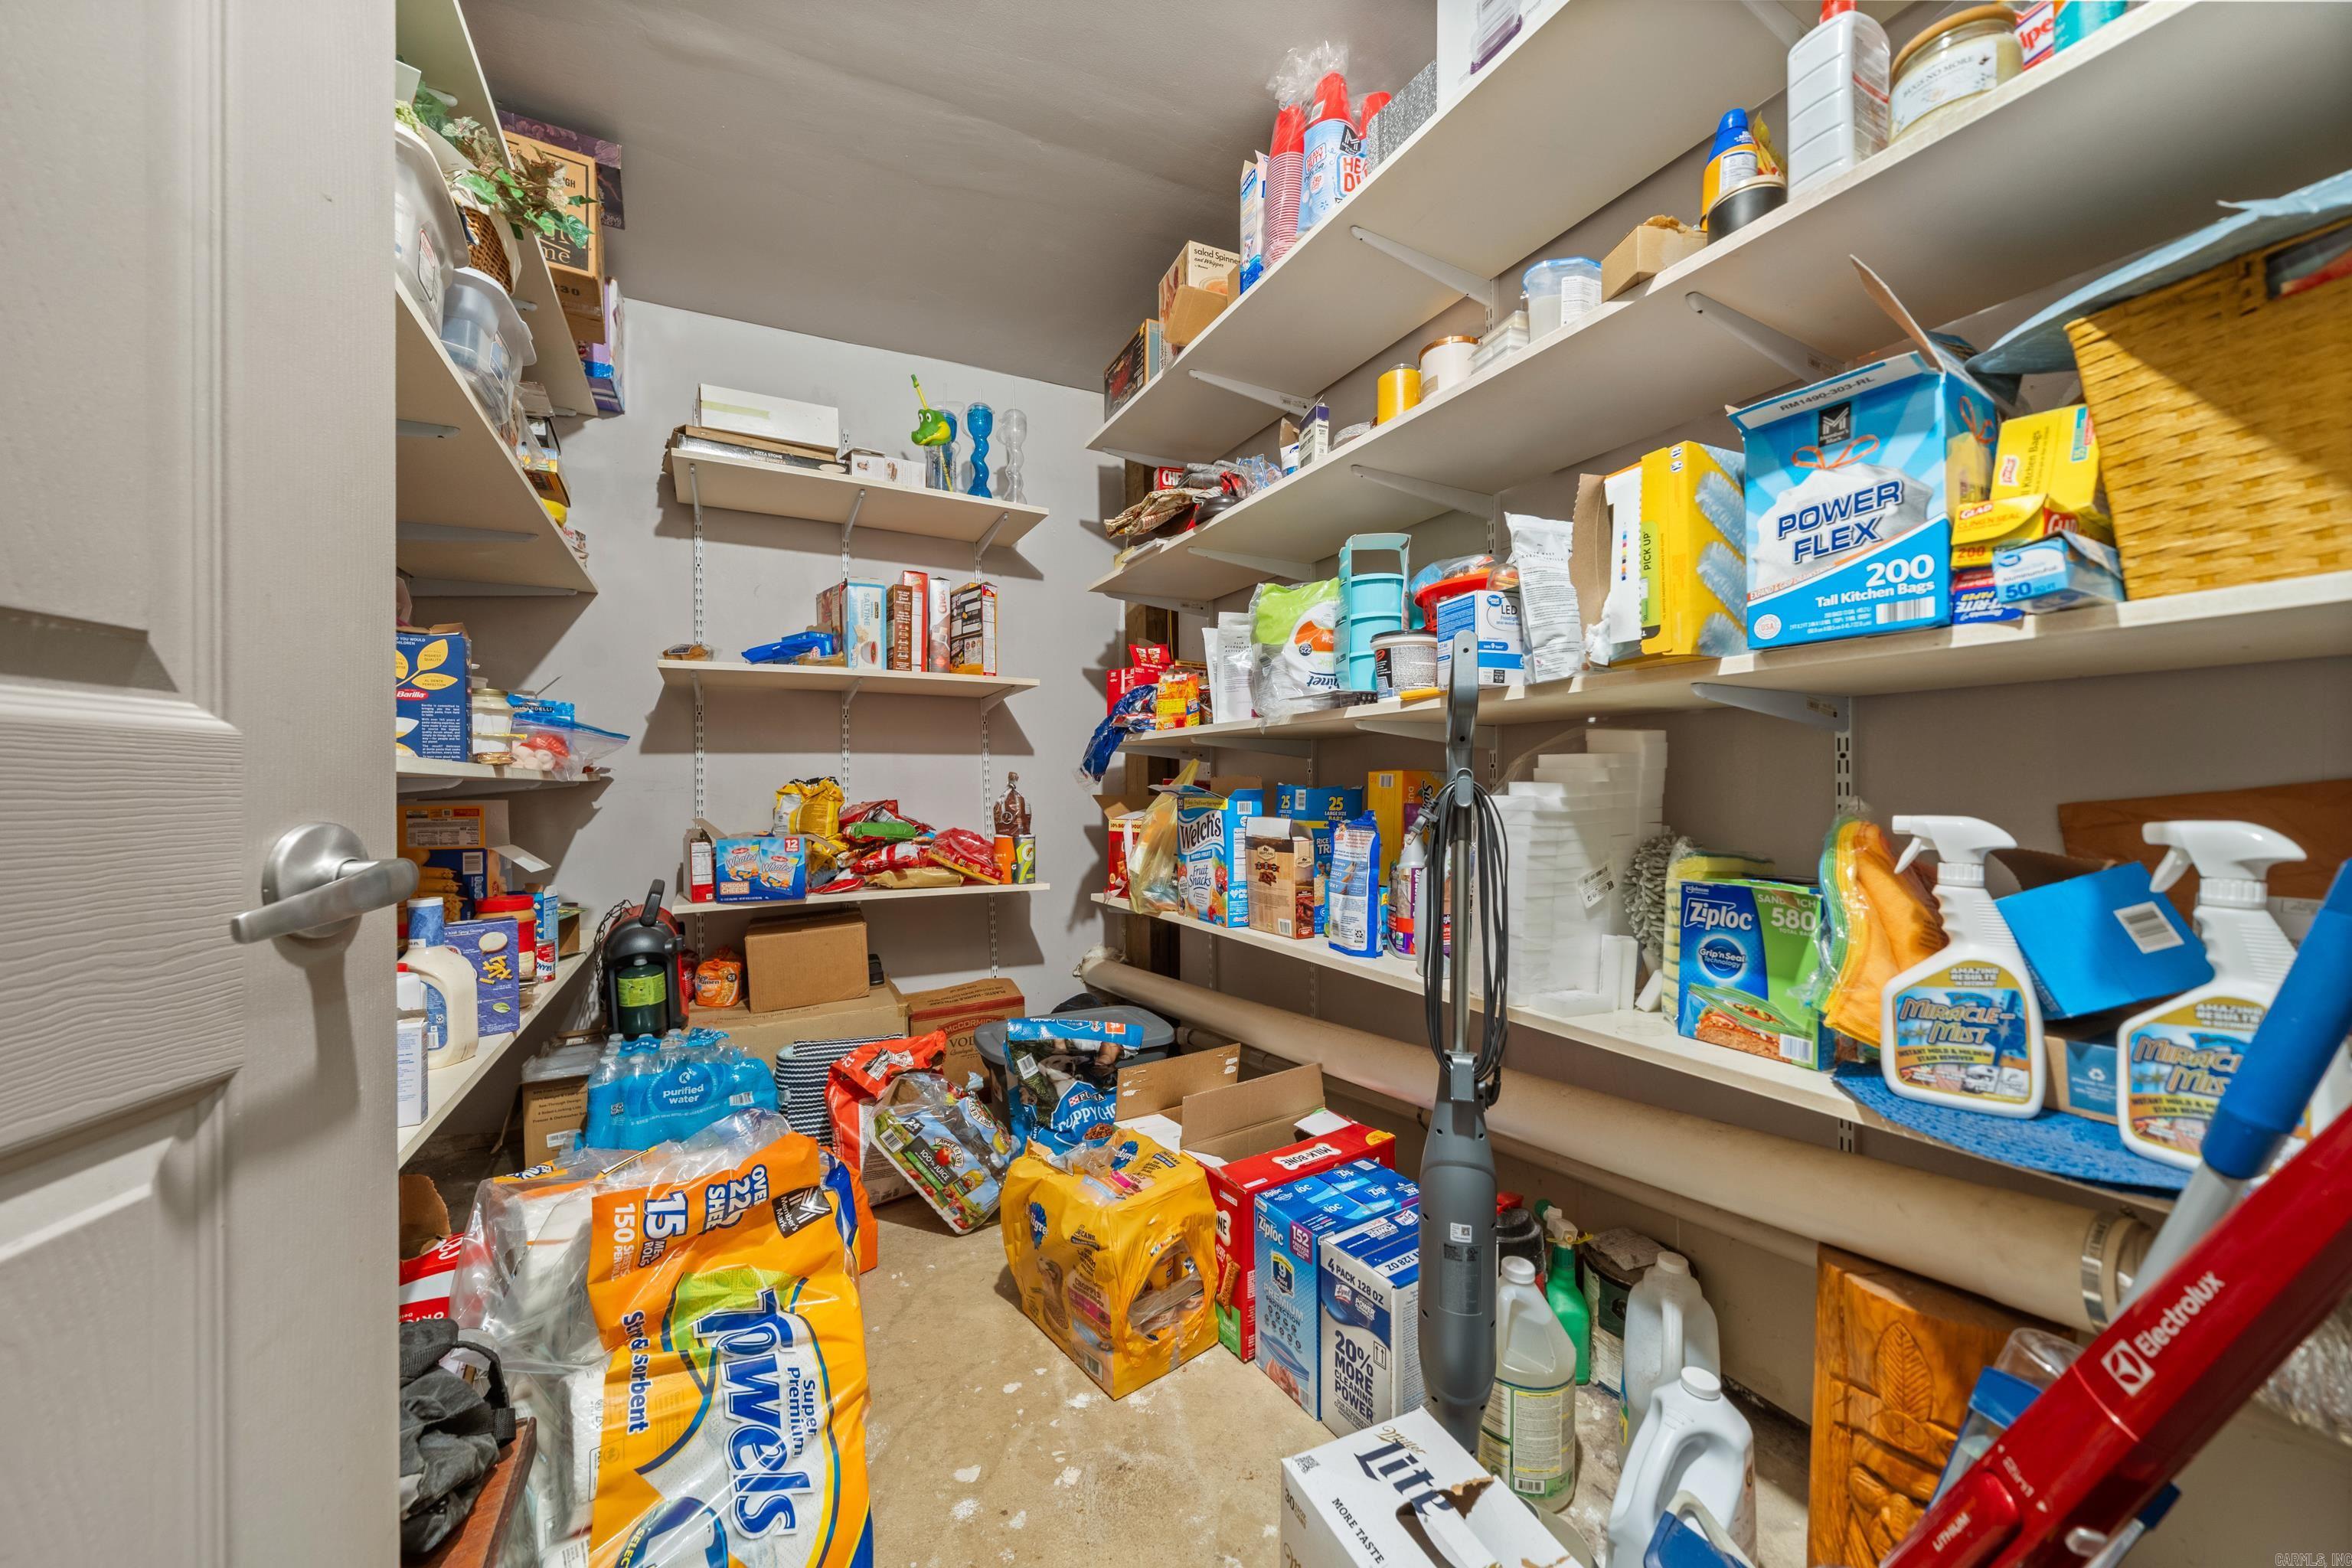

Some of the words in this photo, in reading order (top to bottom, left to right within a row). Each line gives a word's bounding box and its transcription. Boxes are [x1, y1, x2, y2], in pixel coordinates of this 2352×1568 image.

[1943, 55, 1975, 71] MORE
[1306, 146, 1324, 164] HEAVY
[1306, 154, 1324, 172] DUTY
[1194, 247, 1214, 260] salad
[1204, 257, 1224, 269] Whipper
[1779, 376, 1875, 412] RM1490-303-RL
[1162, 470, 1184, 486] CHE
[1777, 480, 1903, 540] POWER
[1960, 504, 1994, 520] GLAD
[1995, 511, 2022, 524] SEAL
[1643, 533, 1651, 546] UP
[1792, 516, 1884, 564] FLEX
[1643, 548, 1651, 570] PICK
[1958, 546, 1985, 559] 200
[1865, 554, 1936, 588] 200
[1815, 596, 1838, 609] Tall
[1841, 585, 1895, 604] Kitchen
[1897, 581, 1936, 596] Bags
[2005, 583, 2032, 599] 50
[1501, 605, 1518, 616] LED
[397, 690, 426, 698] Barilla
[1282, 795, 1291, 809] 25
[1328, 796, 1344, 812] 25
[1180, 813, 1222, 850] Welch's
[786, 839, 799, 848] 12
[726, 851, 758, 869] Whales
[1191, 851, 1201, 860] MIXED
[1201, 850, 1212, 858] FRUIT
[761, 861, 794, 873] Whales
[1193, 864, 1209, 876] Fruit
[1187, 874, 1212, 888] Snacks
[1757, 893, 1817, 908] SANDICH
[1689, 901, 1753, 931] Ziploc
[1770, 907, 1816, 931] 580
[1779, 927, 1798, 936] TOTAL
[1699, 947, 1725, 958] Grip'n
[1725, 952, 1746, 962] Seal
[1704, 956, 1741, 969] Technology
[1950, 967, 2000, 975] AMAZING
[985, 989, 1006, 998] PLASTIC
[1900, 998, 2016, 1024] MIRACLE-
[1927, 1021, 1990, 1044] MIST
[1898, 1048, 1926, 1057] INSTANT
[1959, 1049, 1992, 1058] MILDEW
[663, 1084, 704, 1098] purified
[669, 1094, 700, 1105] water
[907, 1119, 920, 1130] 24
[1280, 1145, 1332, 1166] MILK-BONE
[919, 1149, 936, 1168] 100%
[933, 1164, 951, 1181] JUICE
[1262, 1187, 1283, 1198] Ziploc
[645, 1191, 688, 1239] 15
[775, 1207, 787, 1232] Mark
[779, 1195, 799, 1232] Member's
[613, 1203, 636, 1243] 150
[1257, 1214, 1284, 1246] Ziploc
[1291, 1225, 1310, 1248] 152
[613, 1245, 623, 1266] PER
[1292, 1240, 1310, 1255] FREEZER
[1292, 1246, 1310, 1259] GALLON
[1385, 1259, 1400, 1271] OZ
[1400, 1254, 1416, 1266] 128
[1278, 1264, 1287, 1279] 9
[1327, 1258, 1336, 1273] 4
[1335, 1266, 1356, 1285] PACK
[1357, 1279, 1372, 1296] 128
[1372, 1289, 1384, 1306] OZ
[1335, 1284, 1351, 1300] Lysol
[1263, 1283, 1304, 1321] PREMIUM
[1355, 1298, 1376, 1316] POWER
[1266, 1295, 1301, 1328] PROTECTION
[2133, 1270, 2226, 1360] Electrolux
[1334, 1330, 1374, 1378] 20%
[1334, 1351, 1374, 1397] MORE
[1334, 1370, 1374, 1407] CLEANING
[786, 1367, 805, 1456] Premium
[802, 1379, 818, 1437] Super
[1334, 1382, 1374, 1425] POWER
[692, 1286, 815, 1540] Towels
[1374, 1424, 1428, 1455] Miller
[1354, 1439, 1455, 1517] Lite
[1285, 1488, 1295, 1510] 30
[1331, 1496, 1357, 1529] MORE
[1357, 1527, 1386, 1565] TASTE
[1932, 1512, 1971, 1552] LITHIUM
[620, 1526, 645, 1568] SELEC
